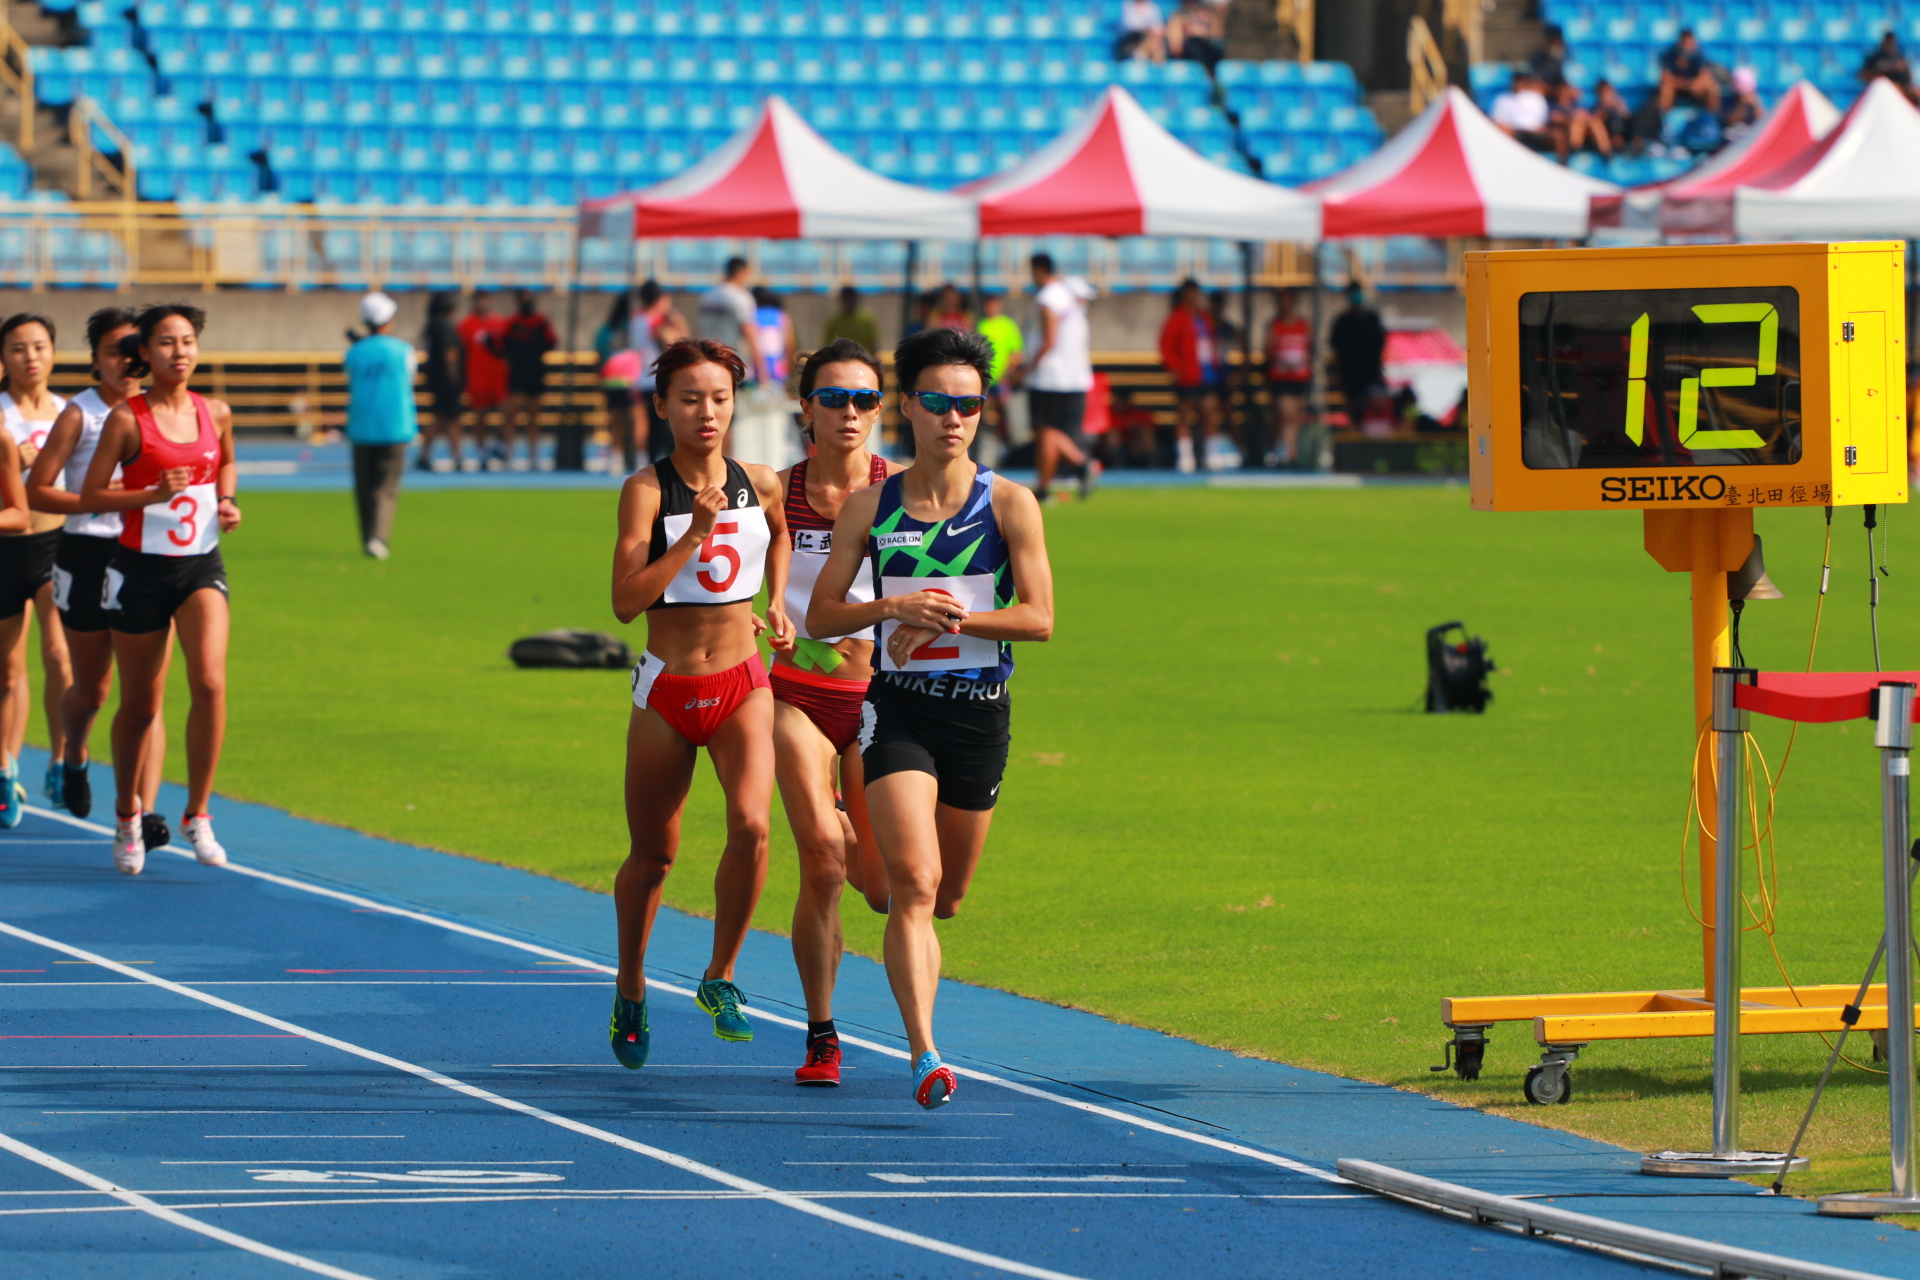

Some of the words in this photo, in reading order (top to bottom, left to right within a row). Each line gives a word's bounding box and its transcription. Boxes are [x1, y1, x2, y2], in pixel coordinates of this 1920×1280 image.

[1625, 302, 1779, 450] 12
[1601, 475, 1726, 502] SEIKO
[1724, 484, 1831, 506] 臺北田徑場
[167, 495, 198, 547] 3
[887, 536, 907, 545] RACE
[908, 535, 921, 543] ON
[696, 521, 741, 594] 5
[885, 673, 949, 698] NIKE
[951, 678, 1001, 701] PRO
